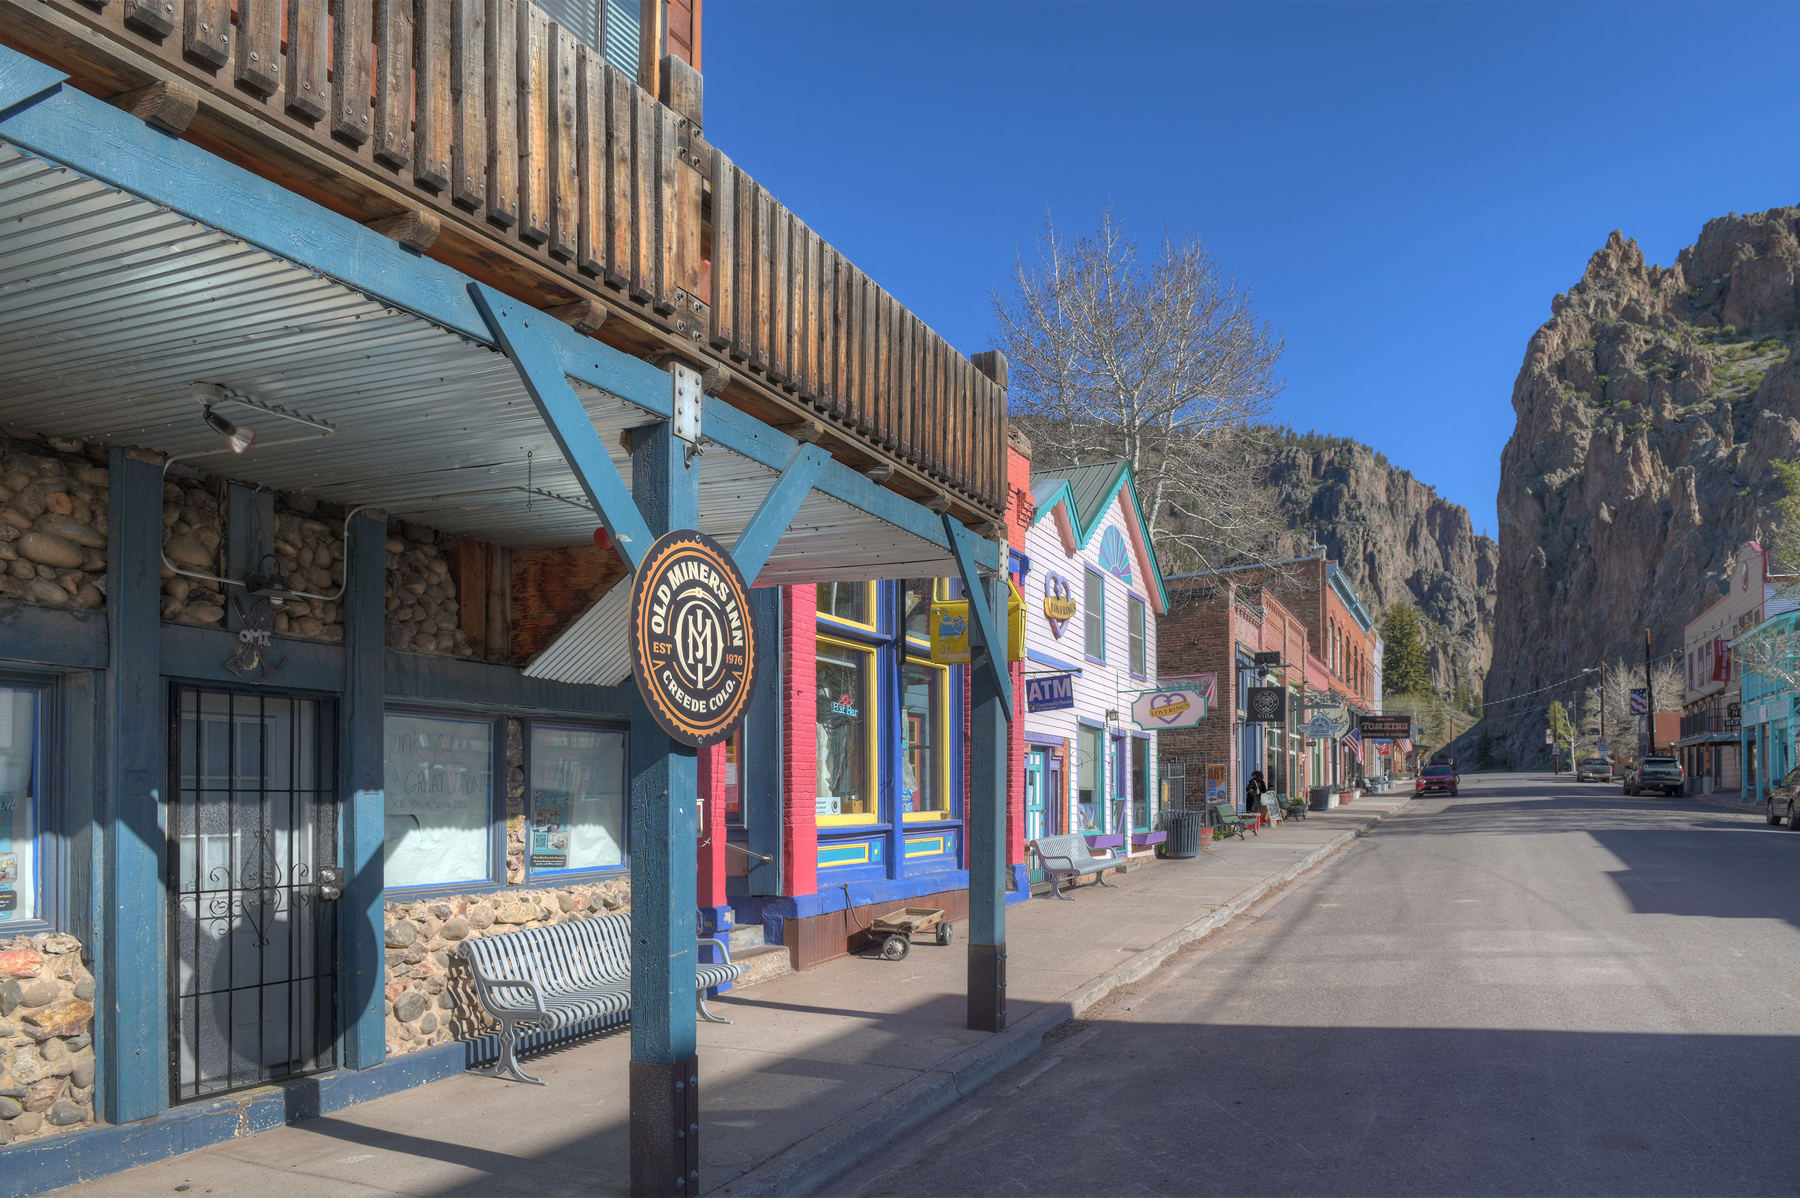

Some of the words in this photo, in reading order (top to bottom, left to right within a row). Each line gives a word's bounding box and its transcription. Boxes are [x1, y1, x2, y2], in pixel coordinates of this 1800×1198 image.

[651, 584, 671, 635] OLD
[667, 561, 730, 602] MINERS
[725, 598, 744, 647] INN
[239, 628, 271, 647] OMI
[653, 641, 673, 655] EST
[725, 653, 743, 666] 1976
[662, 669, 707, 713] CREEDE
[709, 680, 736, 712] COLO.
[1029, 677, 1071, 702] ATM
[846, 705, 858, 716] Bar
[1151, 703, 1190, 716] LOVERING'S
[1361, 722, 1408, 730] TOMKINS
[428, 733, 457, 769] you
[1208, 767, 1225, 780] ART
[404, 770, 446, 795] GREAT
[1208, 780, 1217, 796] OPEN
[388, 792, 404, 810] See
